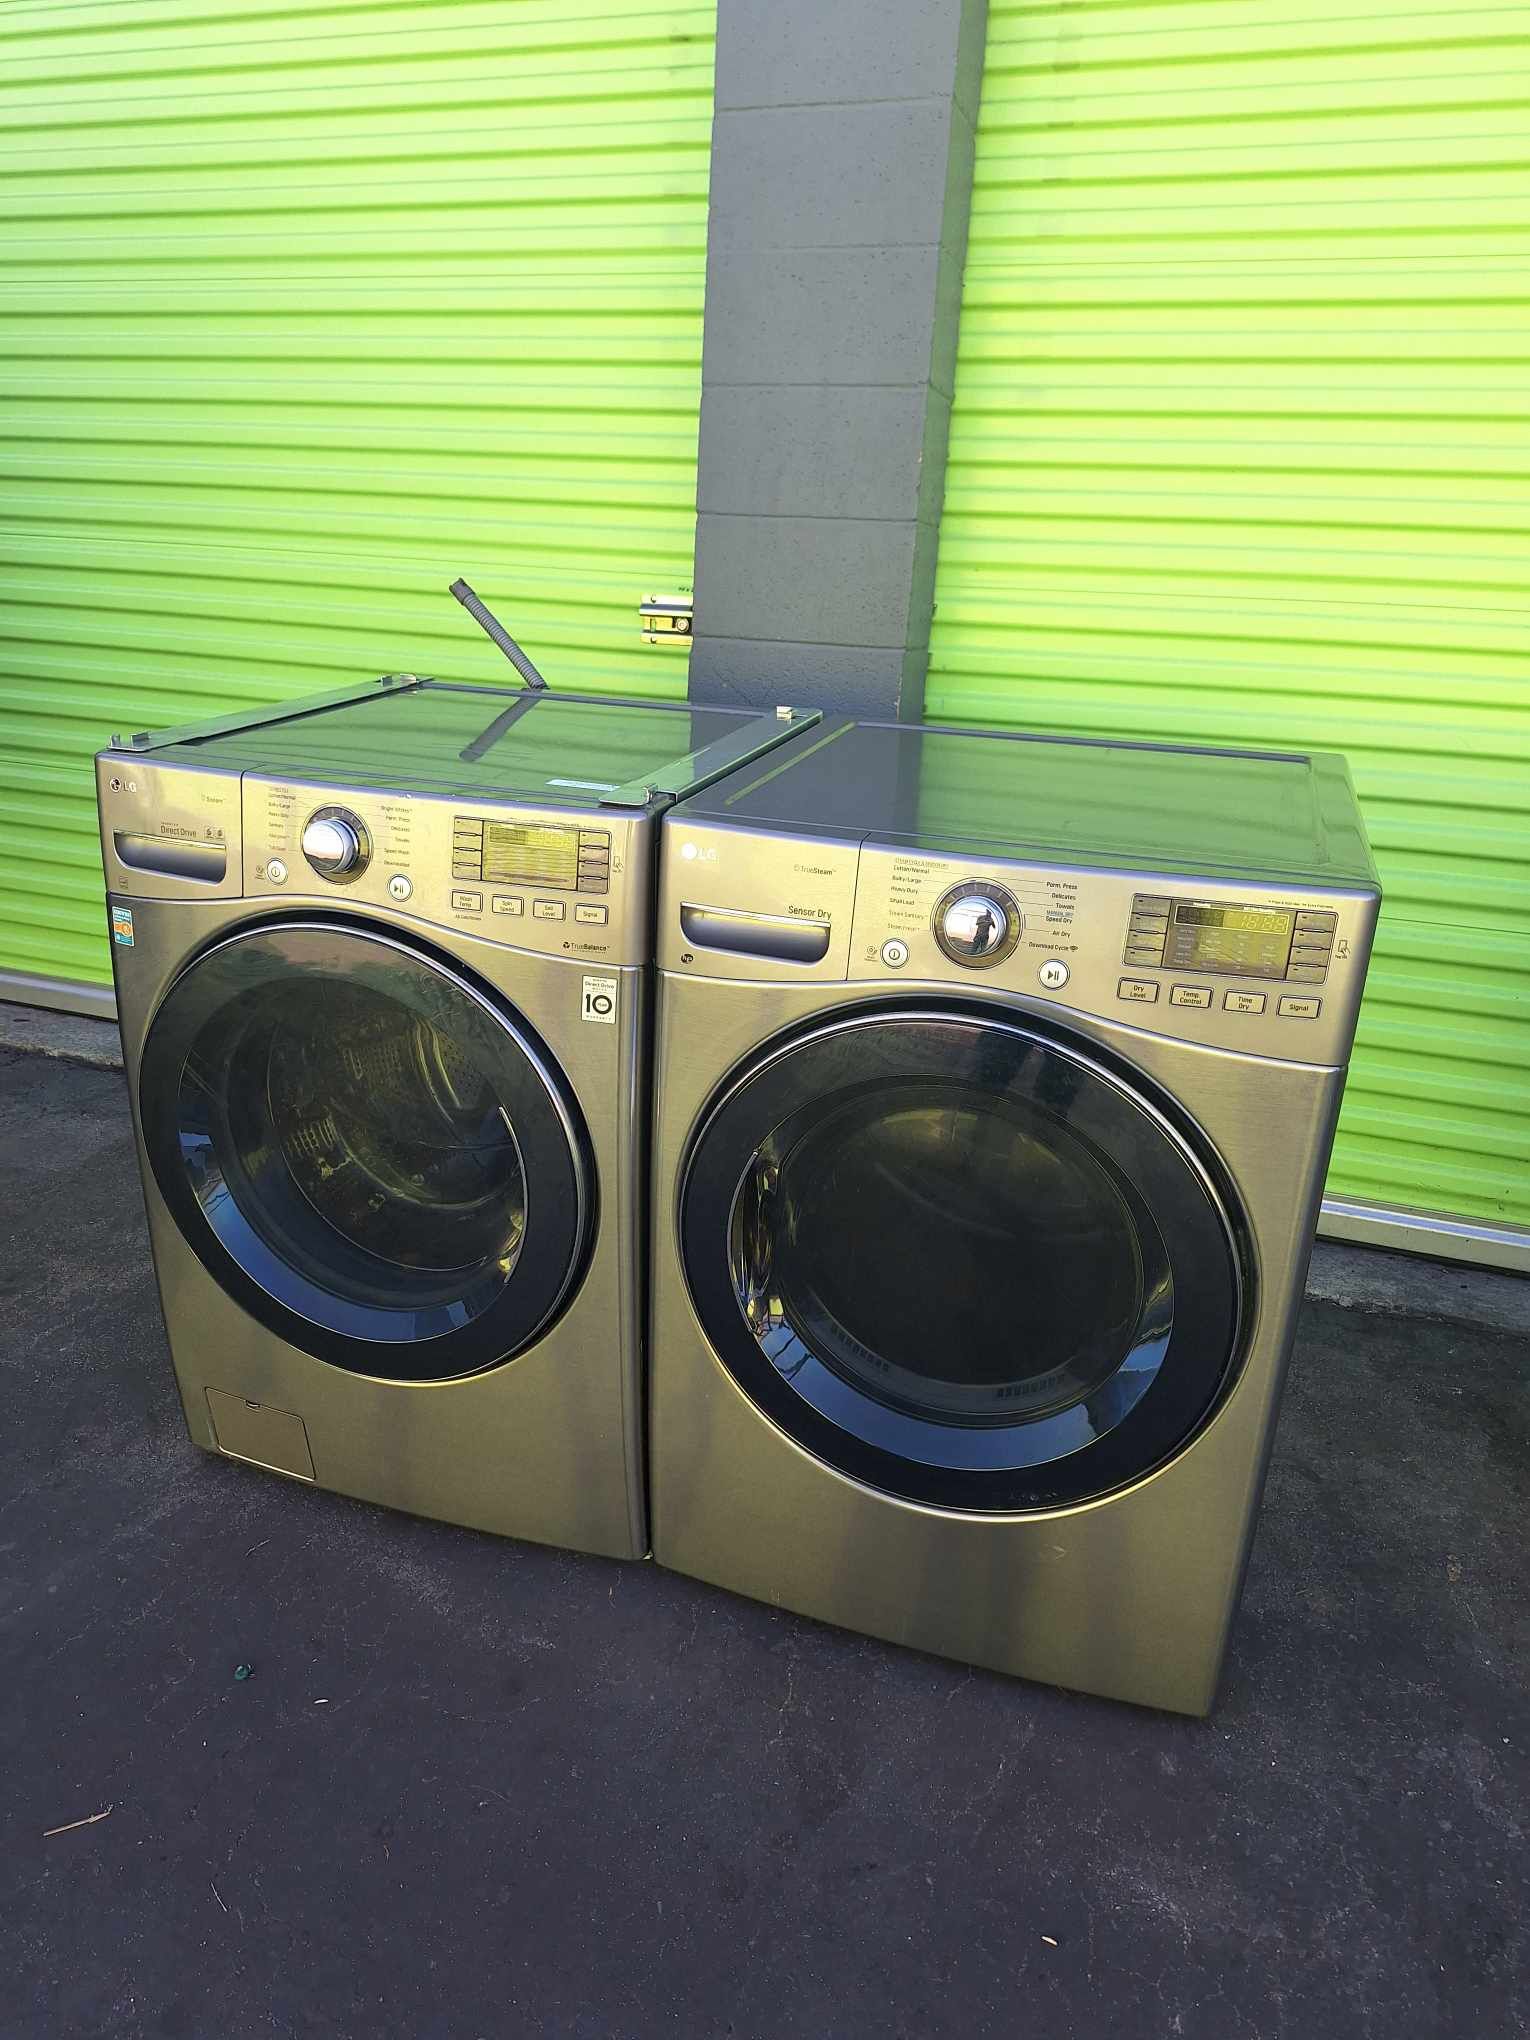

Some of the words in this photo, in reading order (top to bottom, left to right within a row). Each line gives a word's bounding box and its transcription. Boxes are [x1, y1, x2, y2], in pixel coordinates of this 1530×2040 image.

[160, 825, 180, 835] Direct
[180, 827, 197, 838] Drive
[1051, 892, 1077, 901] Delicates
[787, 904, 816, 919] Sensor
[817, 908, 832, 921] Dry
[1063, 917, 1073, 925] Dry
[1061, 931, 1071, 939] Dry
[1054, 944, 1069, 952] Cycle
[1133, 984, 1145, 993] Dry
[1129, 990, 1147, 999] Level
[585, 993, 613, 1015] 10
[1179, 996, 1202, 1006] Control
[1237, 996, 1253, 1004] Time
[1238, 1002, 1250, 1011] Dry
[1288, 1003, 1309, 1012] Signal
